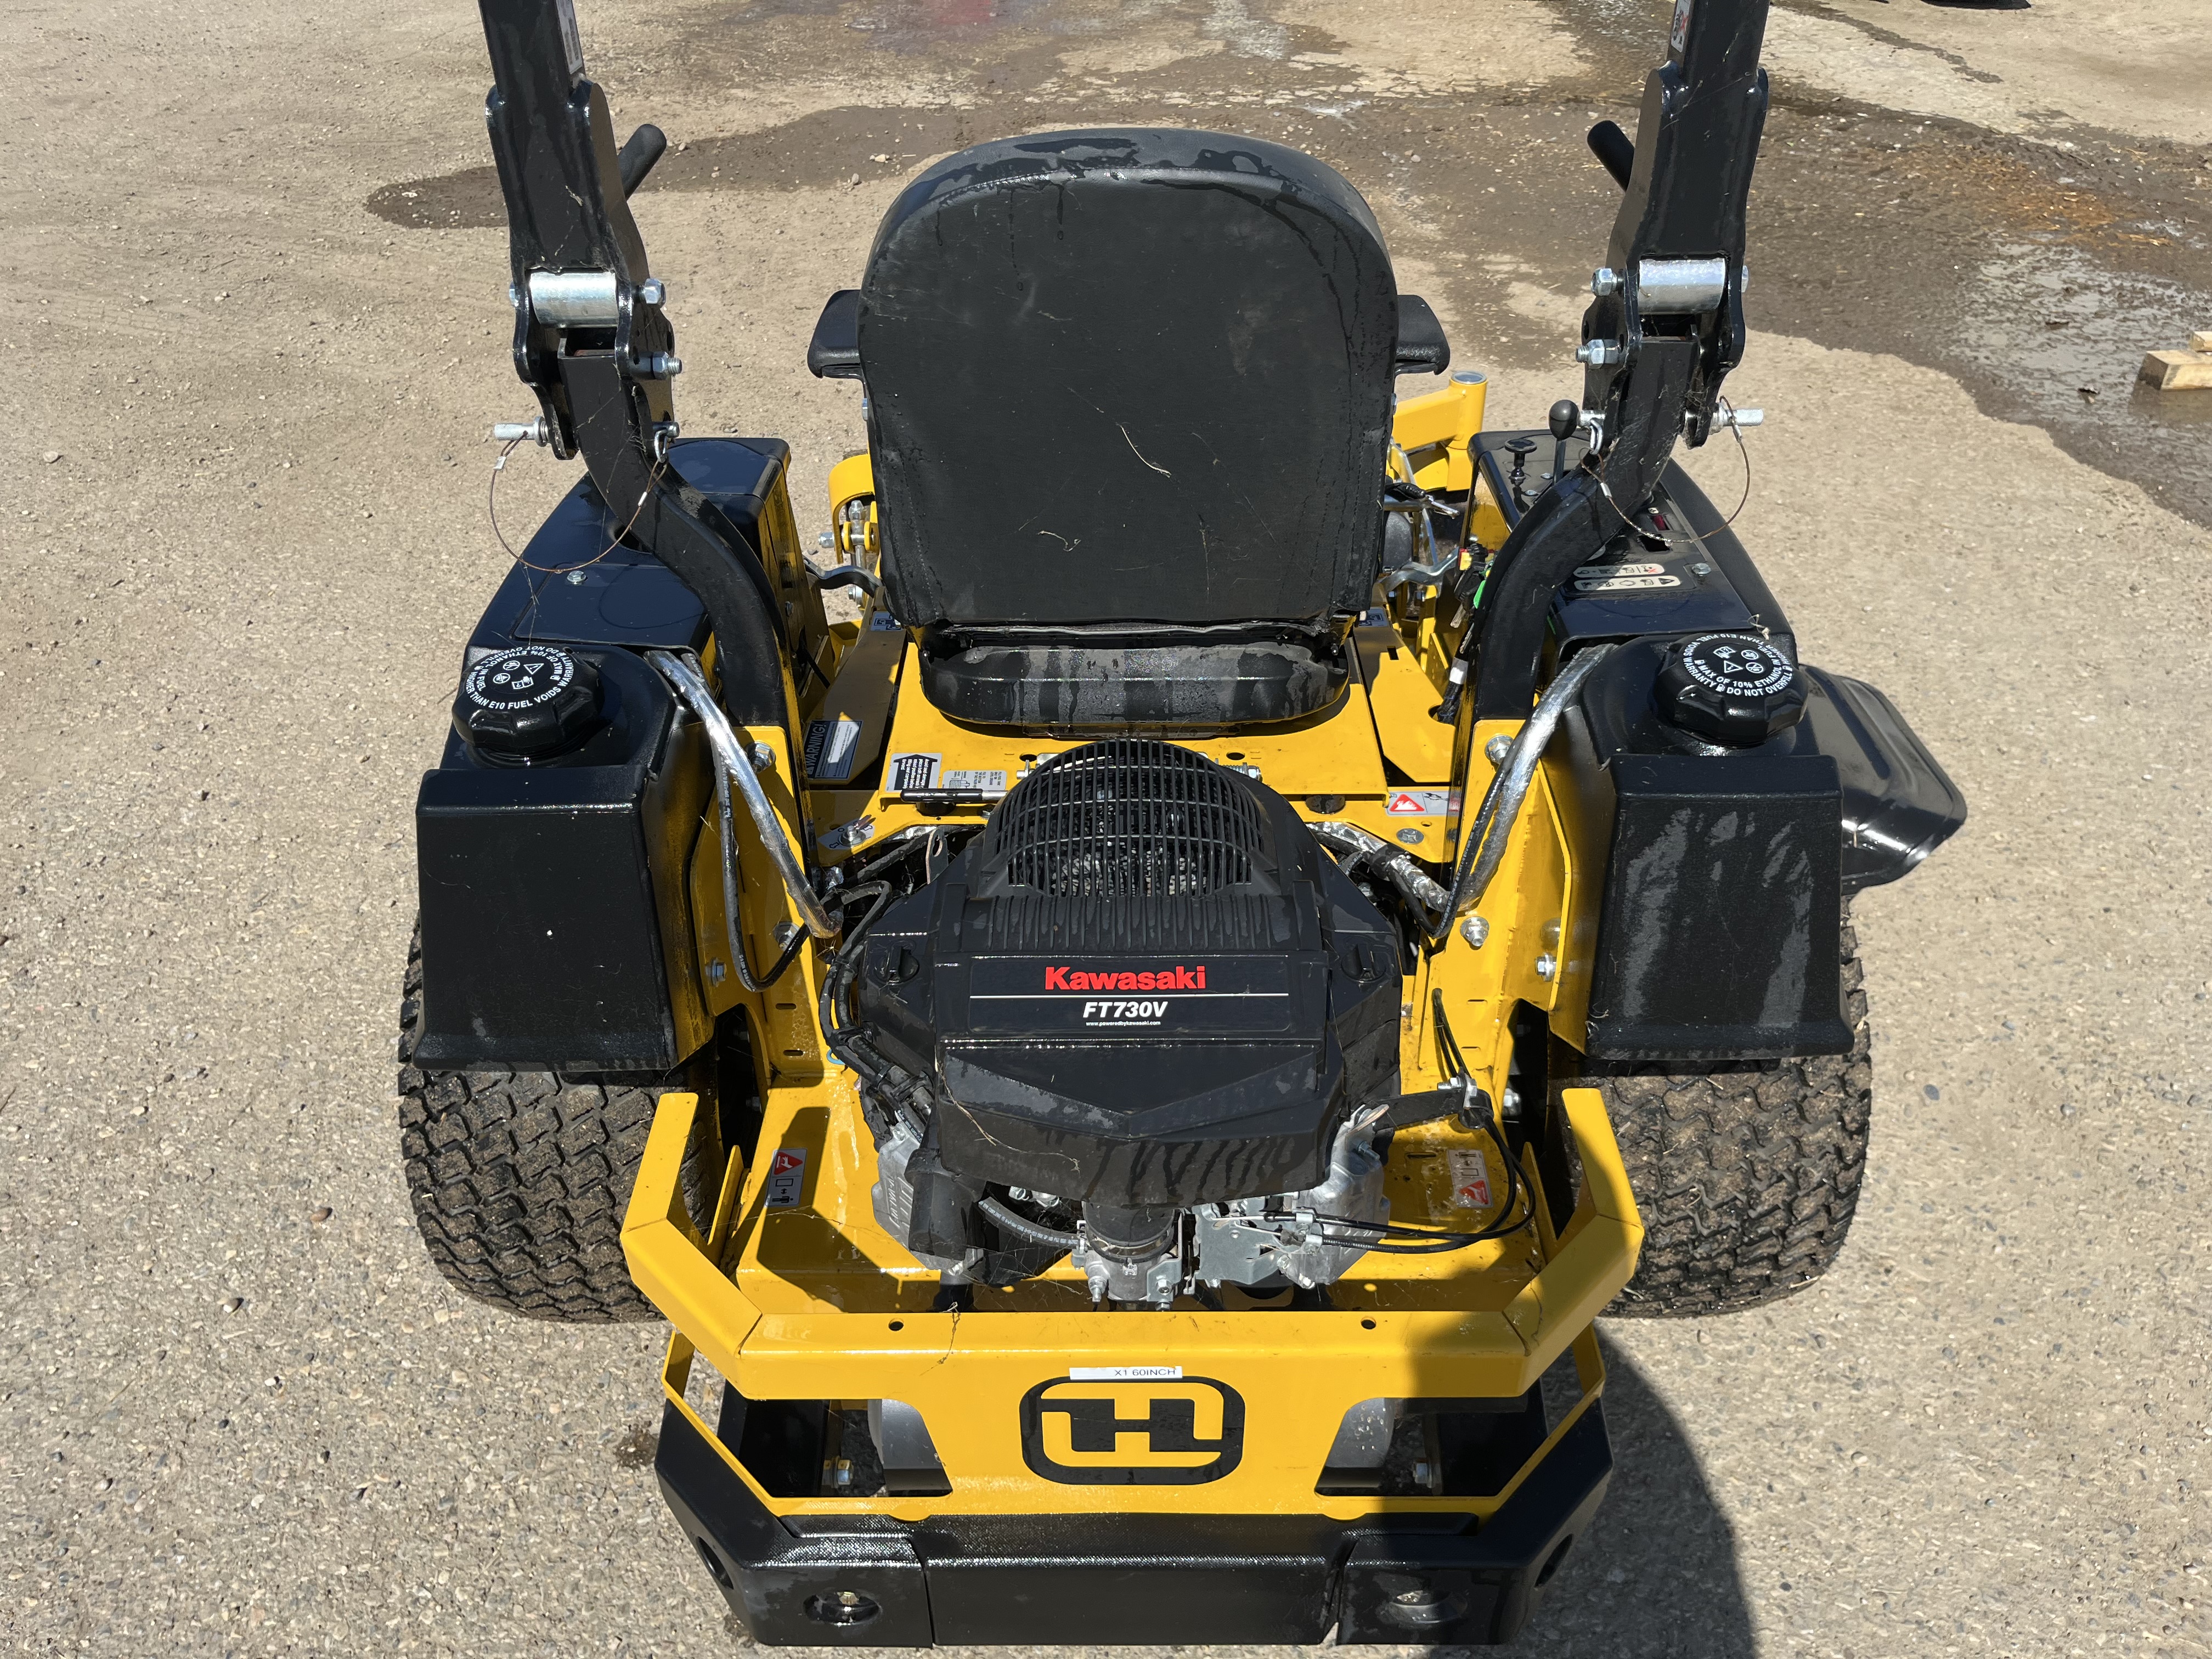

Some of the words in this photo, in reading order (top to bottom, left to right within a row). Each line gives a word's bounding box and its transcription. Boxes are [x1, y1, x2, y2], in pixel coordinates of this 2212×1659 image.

[1683, 641, 1700, 656] VOIDS
[1740, 635, 1764, 646] THAN
[481, 647, 522, 664] OVERFILL
[1757, 645, 1776, 658] FUEL
[1765, 645, 1790, 665] HIGHER
[486, 651, 527, 670] ETHANOL
[553, 662, 562, 674] MAX
[557, 656, 574, 686] WARRANTY
[1683, 658, 1717, 687] WARRANTY
[1698, 664, 1717, 678] MAX
[1754, 667, 1782, 687] ETHANOL
[466, 672, 478, 693] HIGHER
[476, 676, 486, 691] FUEL
[1765, 672, 1792, 693] OVERFILL
[470, 692, 489, 706] THAN
[534, 686, 561, 703] VOIDS
[489, 701, 505, 709] E10
[507, 700, 533, 709] FUEL
[1045, 966, 1206, 990] Kawasaki
[1083, 1001, 1169, 1018] FT730V
